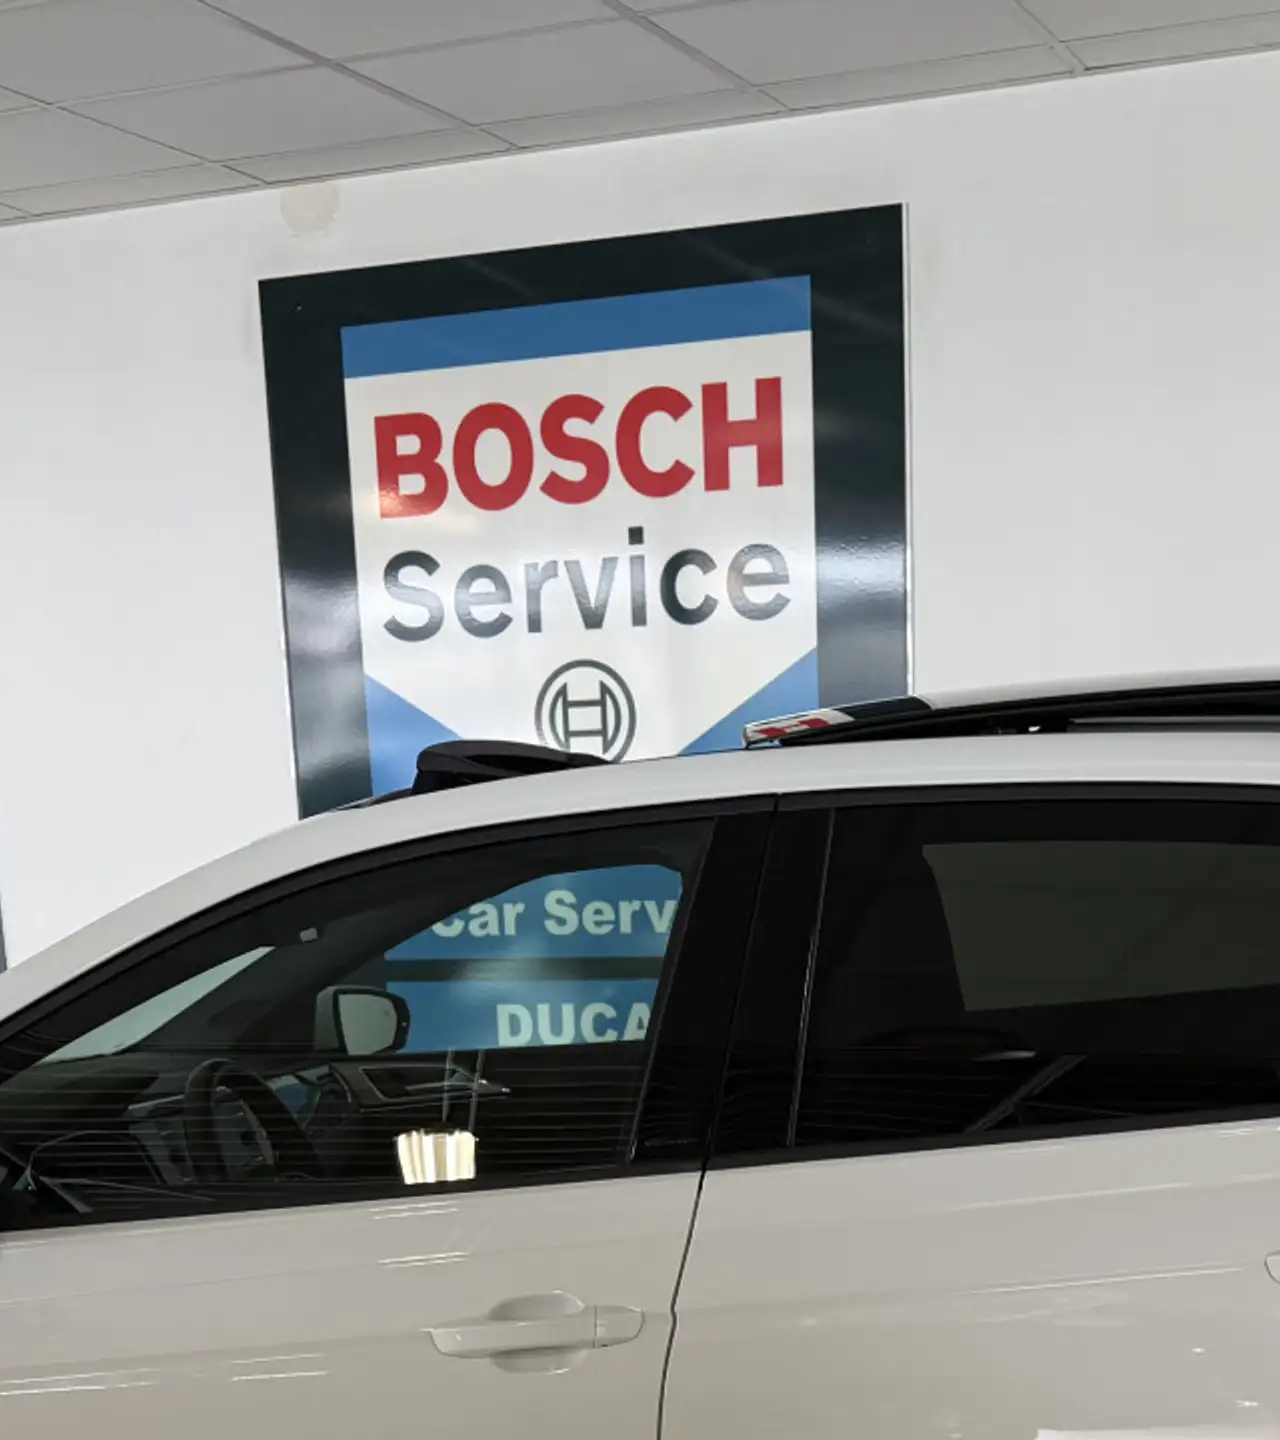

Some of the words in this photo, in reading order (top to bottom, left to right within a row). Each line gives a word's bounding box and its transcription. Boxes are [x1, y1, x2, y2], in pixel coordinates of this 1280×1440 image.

[374, 377, 783, 518] BOSCH
[382, 527, 790, 642] Service
[496, 1002, 651, 1047] DUCA
